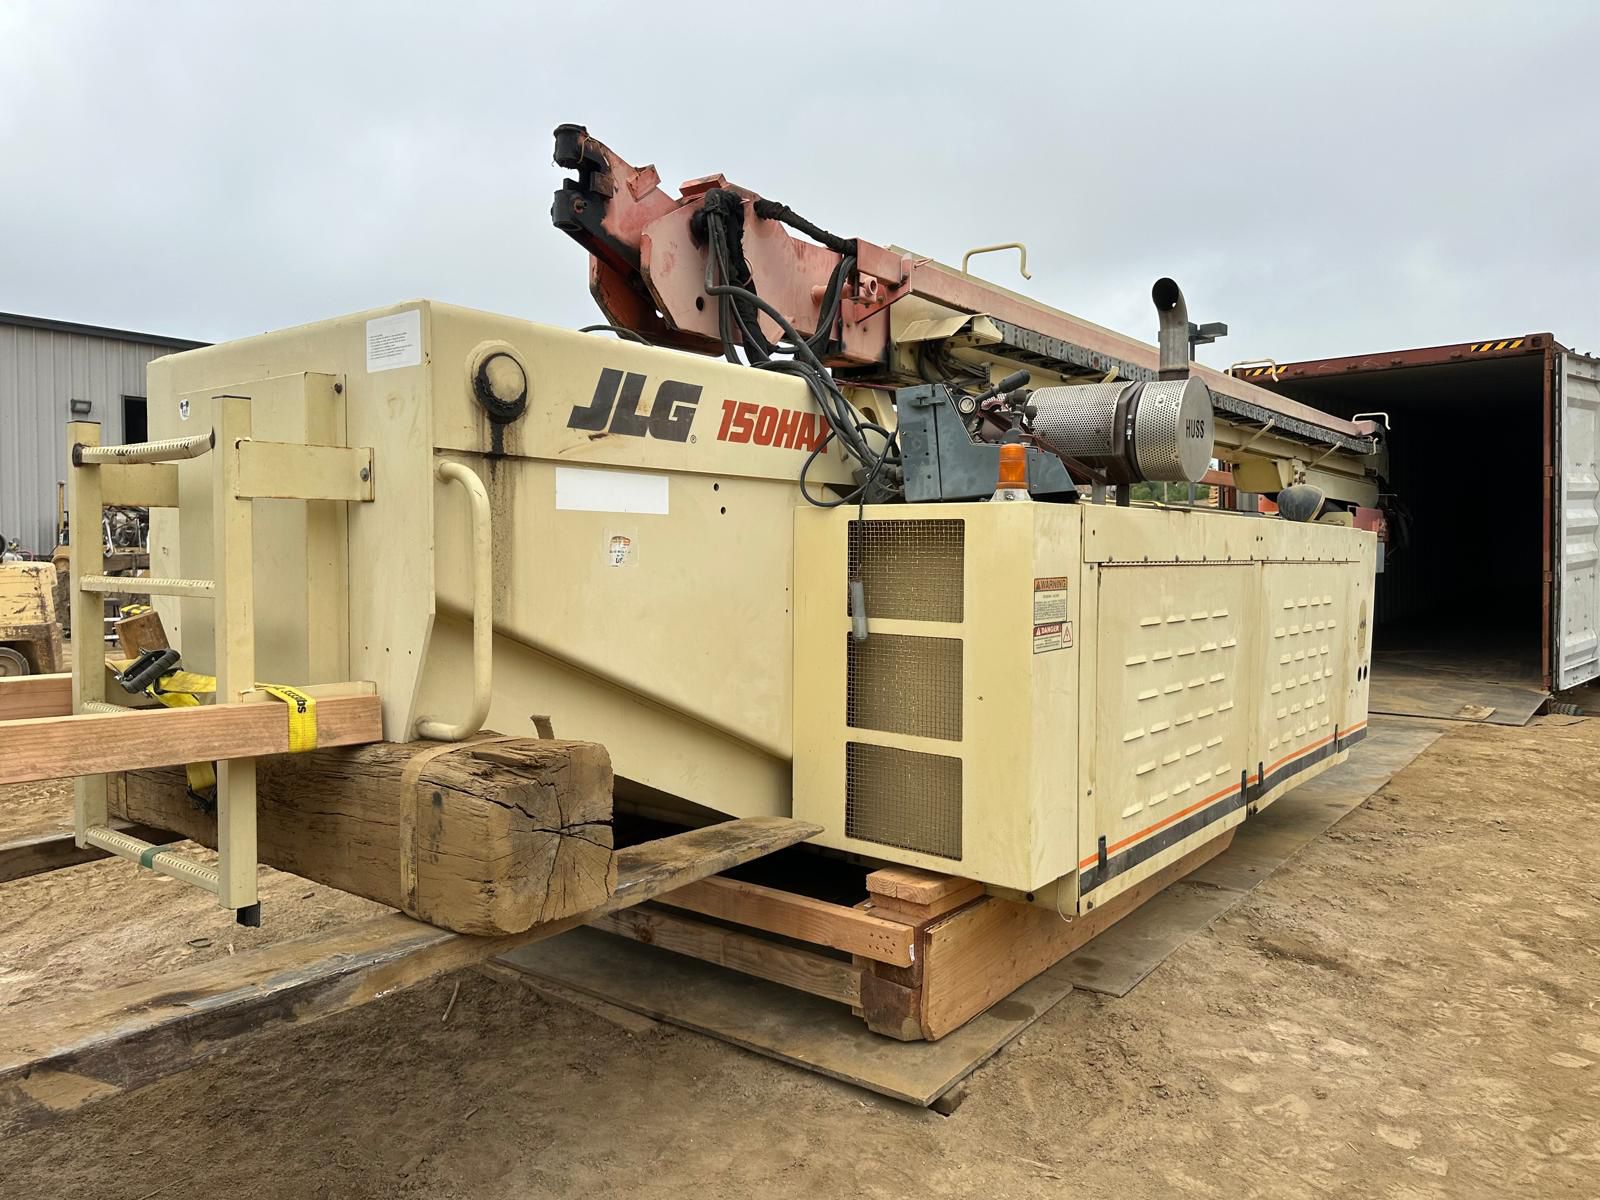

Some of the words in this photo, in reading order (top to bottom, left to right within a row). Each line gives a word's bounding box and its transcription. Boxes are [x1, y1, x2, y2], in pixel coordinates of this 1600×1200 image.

[567, 367, 703, 443] JLG
[1185, 419, 1205, 439] HUSS
[1040, 579, 1066, 590] WARNING
[1040, 625, 1060, 635] DANGER
